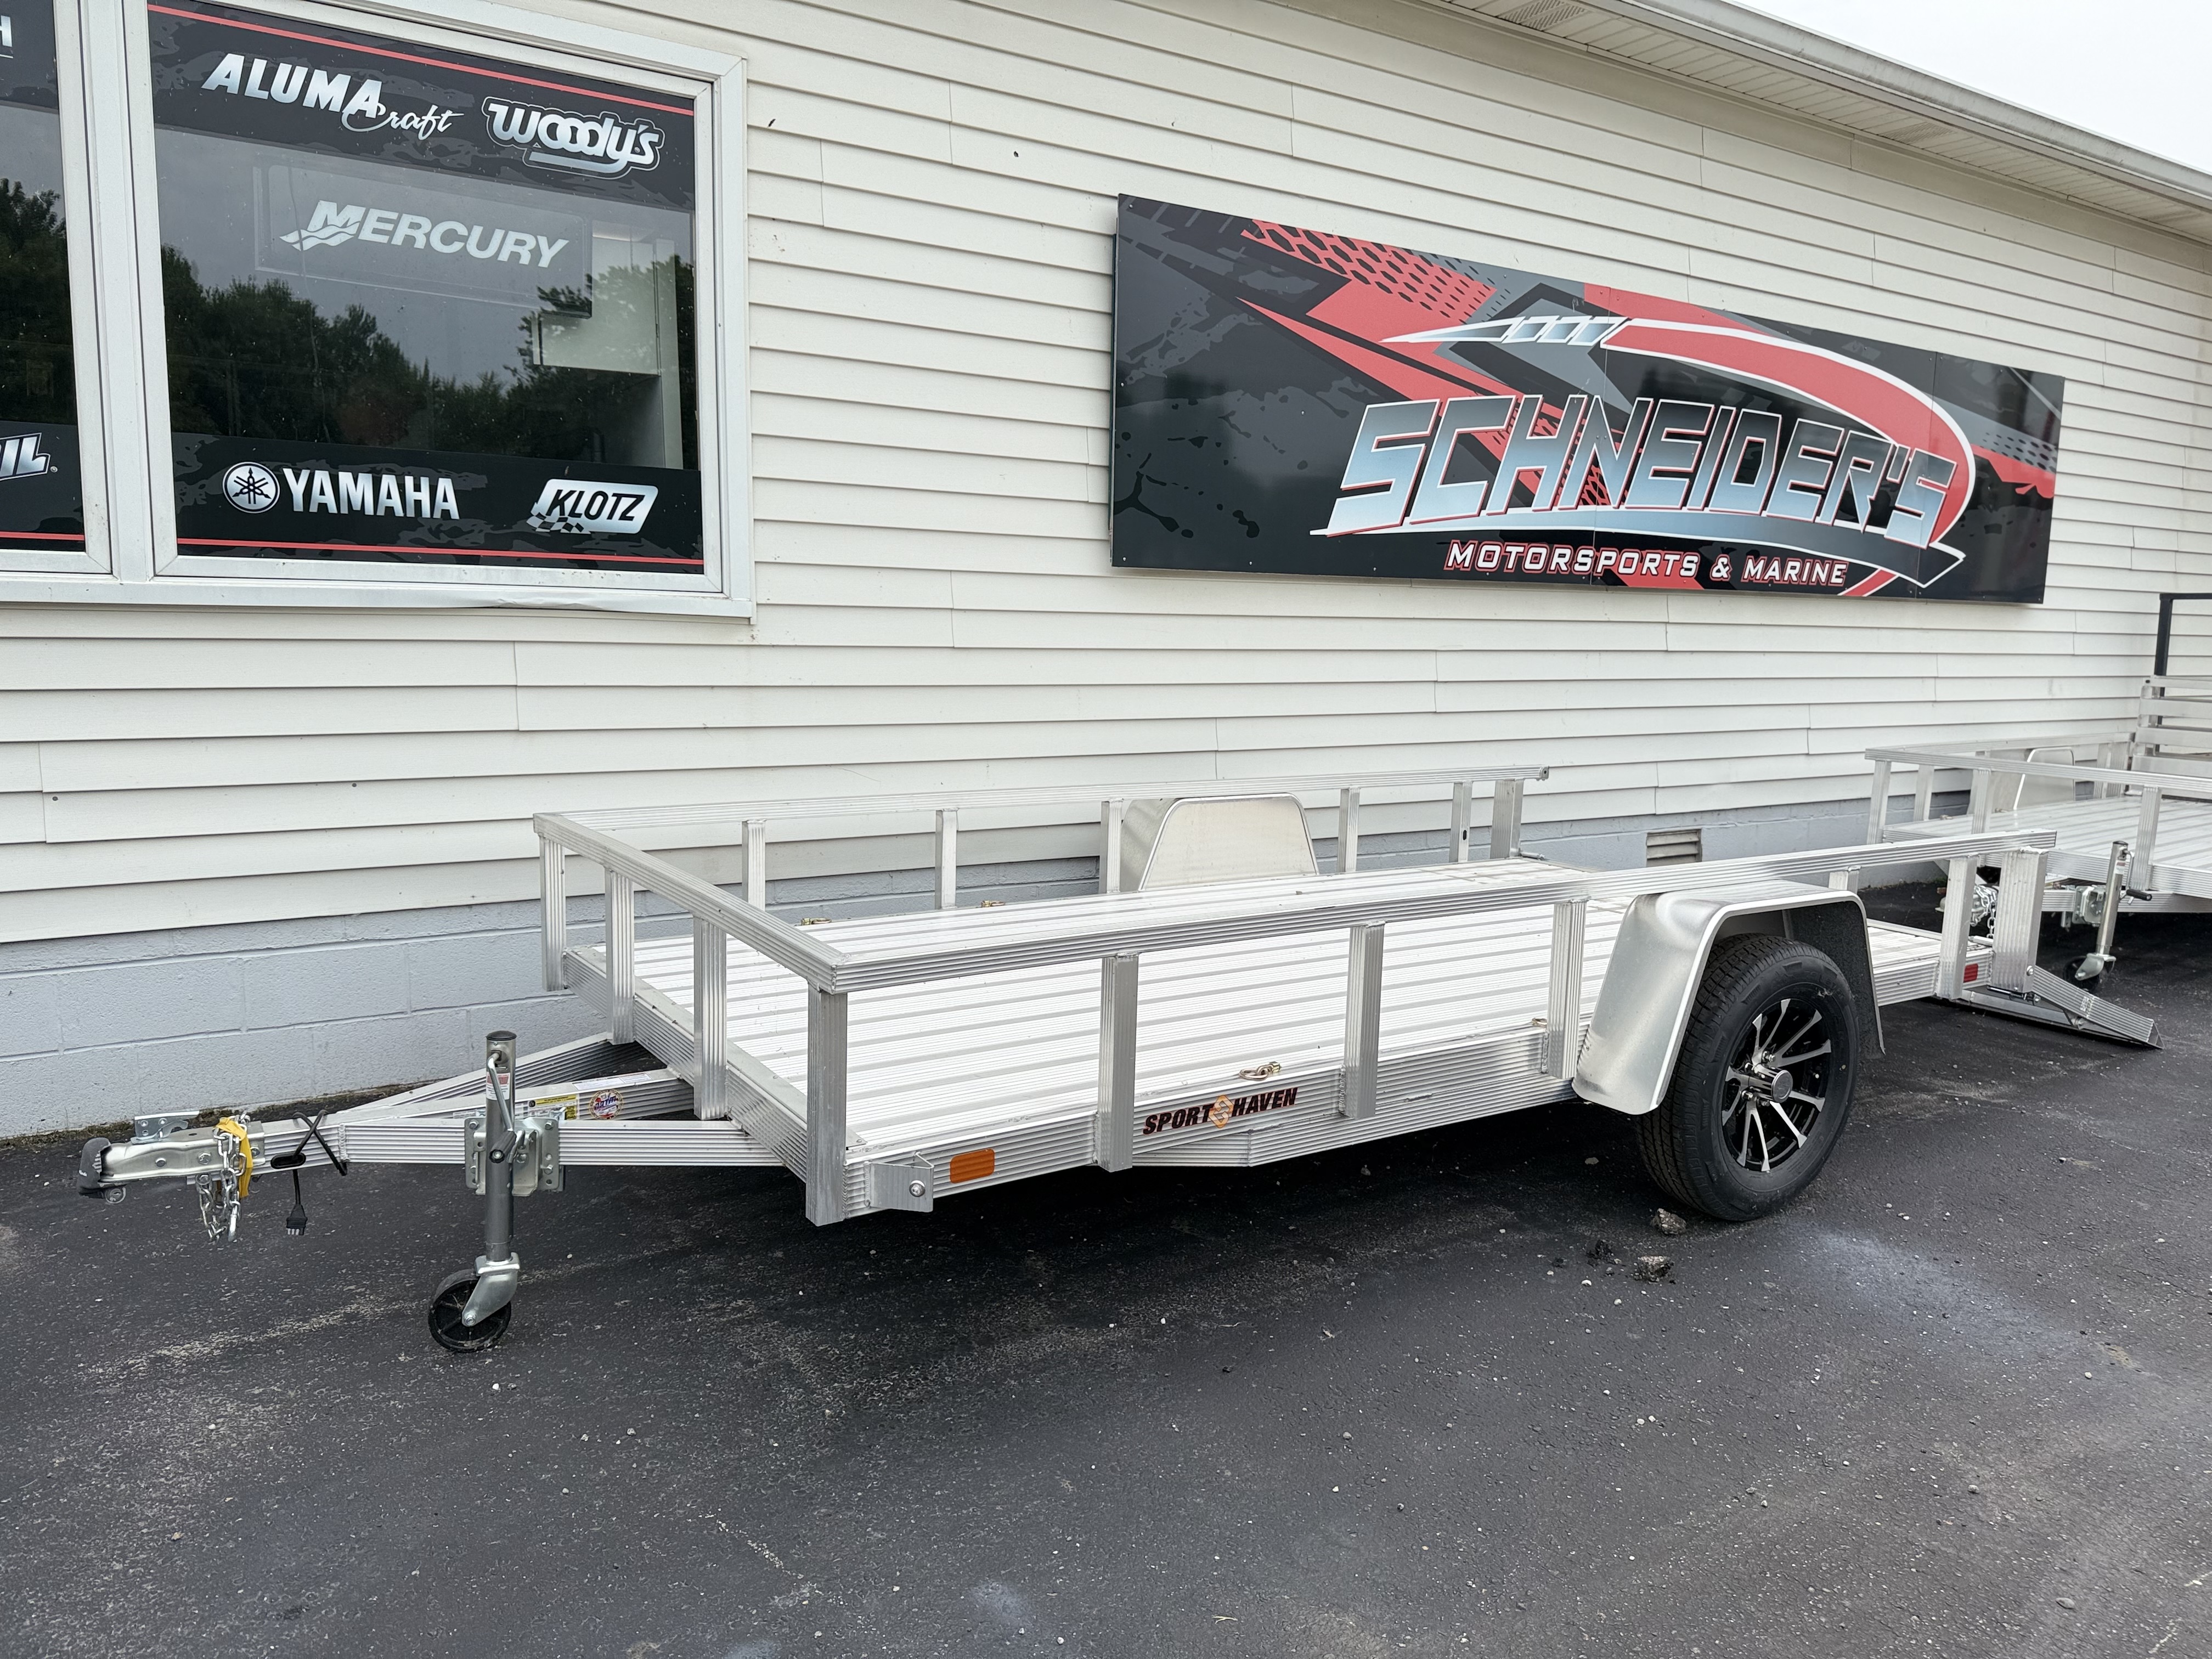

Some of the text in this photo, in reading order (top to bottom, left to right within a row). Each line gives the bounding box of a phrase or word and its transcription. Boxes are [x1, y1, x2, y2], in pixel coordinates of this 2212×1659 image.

[201, 53, 465, 140] ALUMA Craft
[305, 199, 570, 268] MERCURY
[0, 436, 47, 477] IL
[1327, 394, 1956, 548] SCHNEIDER'S
[283, 468, 460, 520] YAMAHA
[545, 488, 646, 522] KLOTZ
[1444, 540, 1850, 587] MOTORSPORTS & MARINE
[1143, 1087, 1299, 1135] SPORT HAVEN
